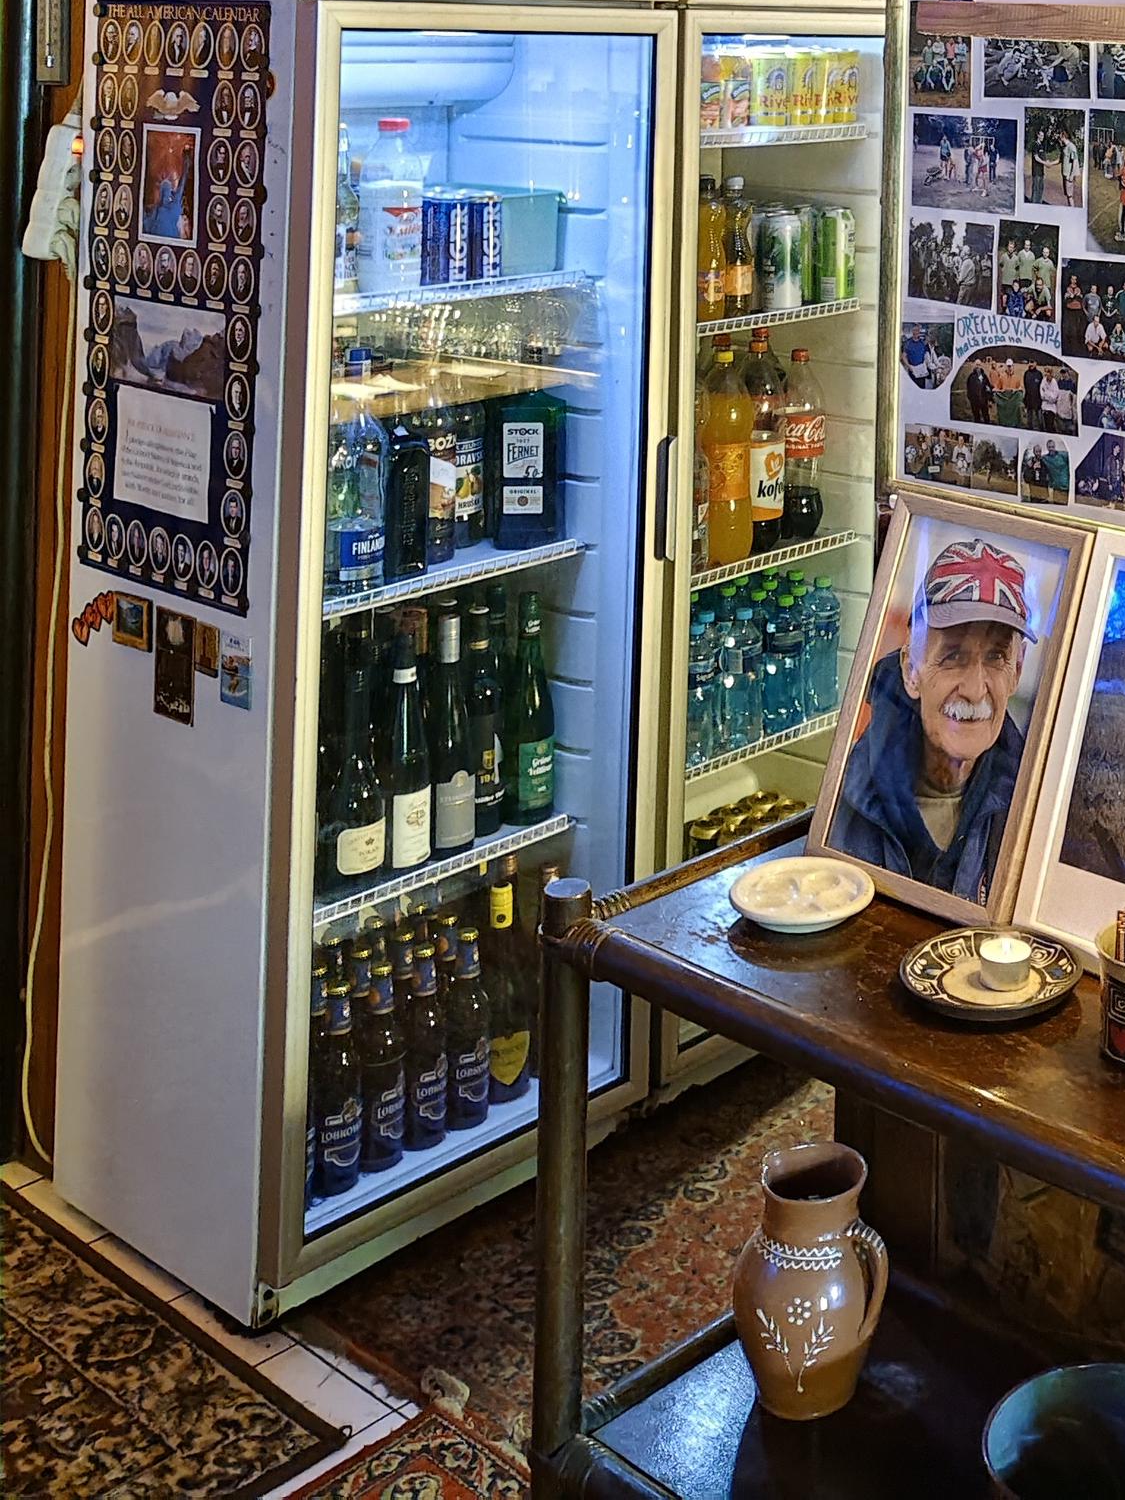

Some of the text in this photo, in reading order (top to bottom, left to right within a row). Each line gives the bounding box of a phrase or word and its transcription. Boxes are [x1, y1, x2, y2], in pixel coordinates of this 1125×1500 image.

[106, 3, 262, 22] THE ALL AMERICAN CALENDAR
[507, 427, 539, 437] STOCK
[507, 445, 540, 465] FERNET
